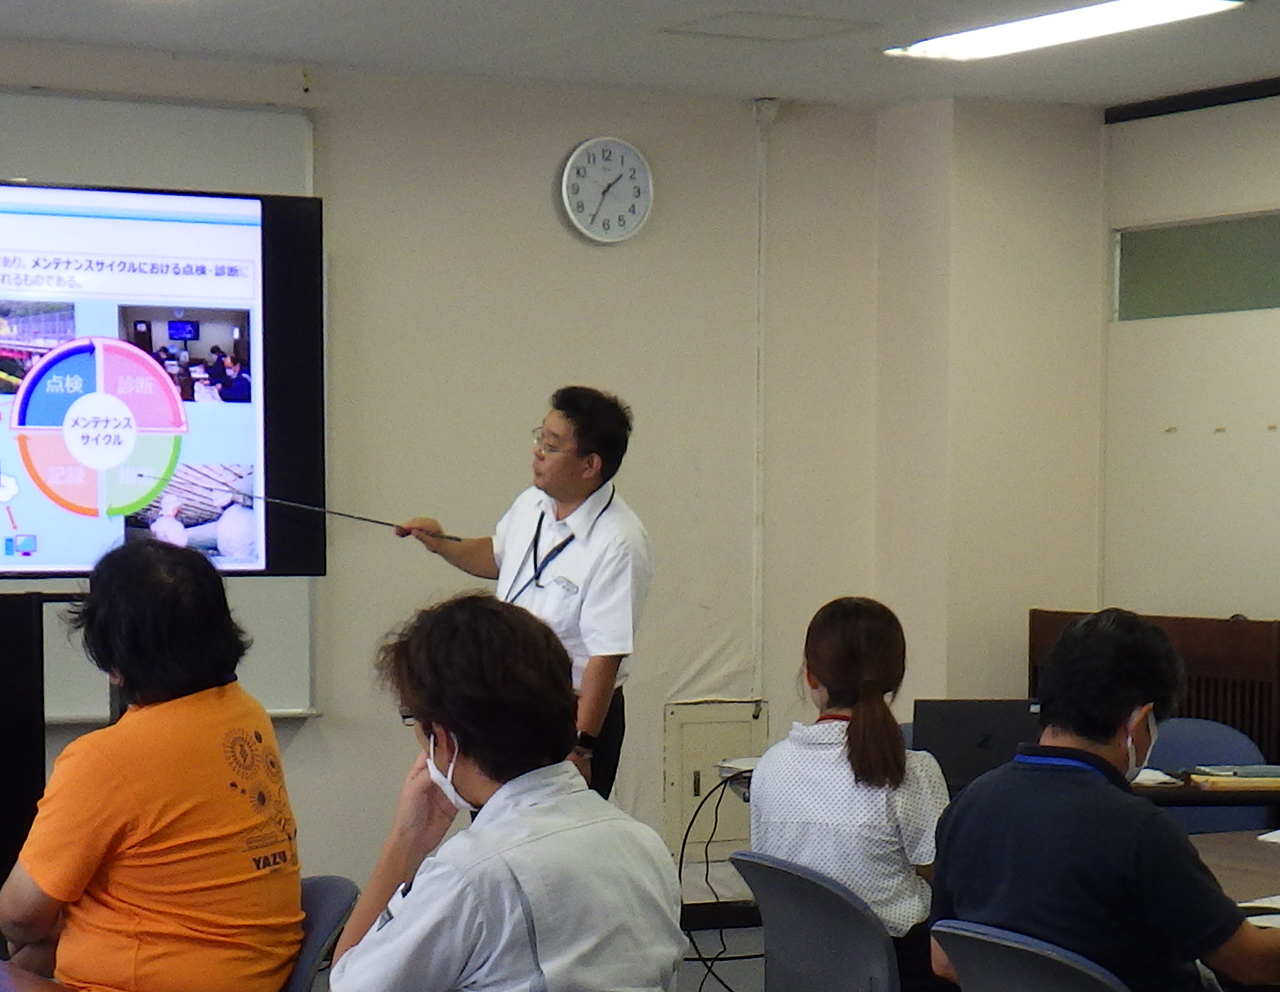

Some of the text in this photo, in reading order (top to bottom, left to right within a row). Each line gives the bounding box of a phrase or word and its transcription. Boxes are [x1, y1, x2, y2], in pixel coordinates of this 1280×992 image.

[587, 153, 596, 165] 11
[602, 148, 612, 161] 12
[576, 166, 587, 178] 10
[629, 168, 636, 180] 2
[572, 182, 580, 195] 9
[633, 185, 641, 198] 3
[576, 201, 585, 213] 8
[628, 204, 636, 215] 4
[602, 219, 610, 230] 6
[618, 214, 626, 227] 5
[45, 374, 84, 394] 点検
[70, 416, 133, 429] メンテナンス
[80, 434, 123, 447] サイクル
